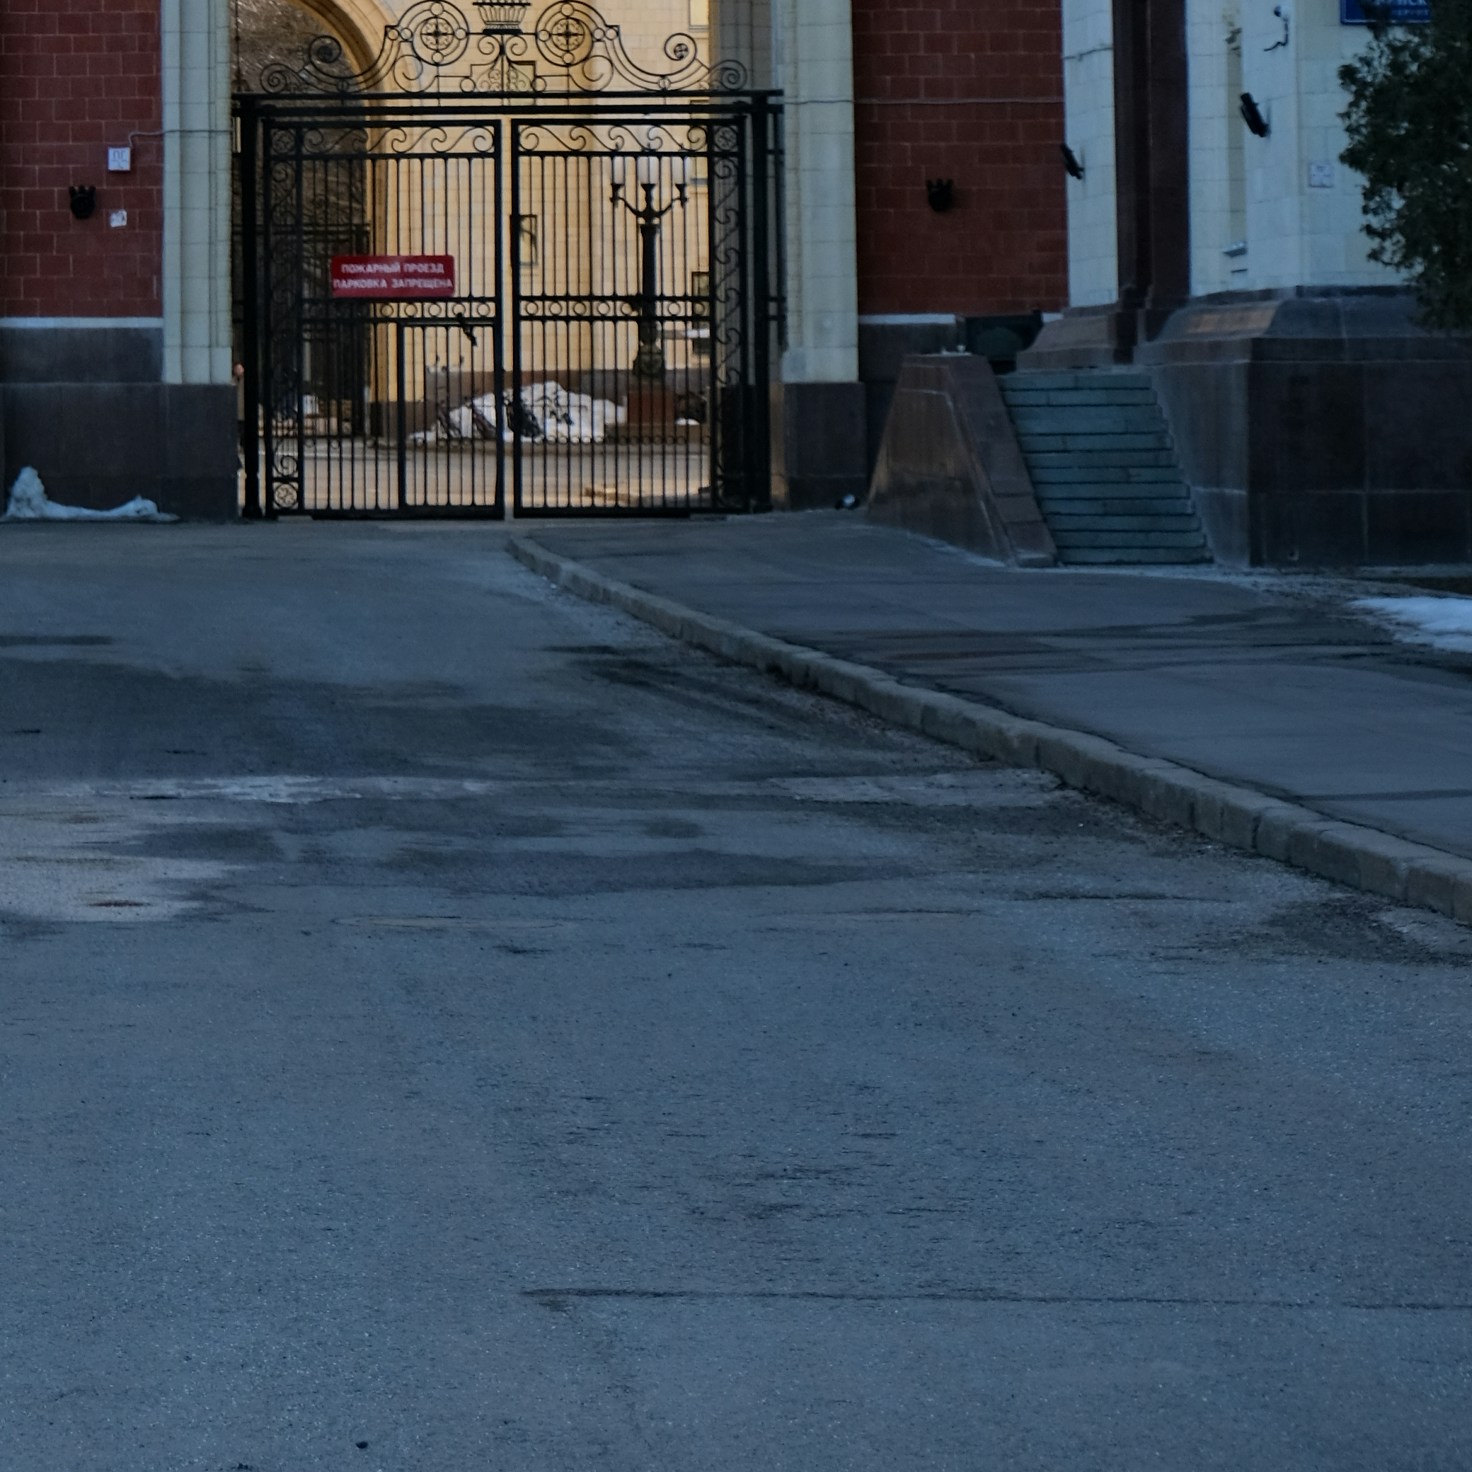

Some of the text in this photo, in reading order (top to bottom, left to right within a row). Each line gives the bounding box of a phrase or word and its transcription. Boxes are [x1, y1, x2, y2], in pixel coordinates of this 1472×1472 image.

[341, 262, 445, 274] ПОЖАРНЫЙ ПРОЕЗД
[333, 279, 453, 289] ПАРКОВКА ЗАПРЕЩЕНА
